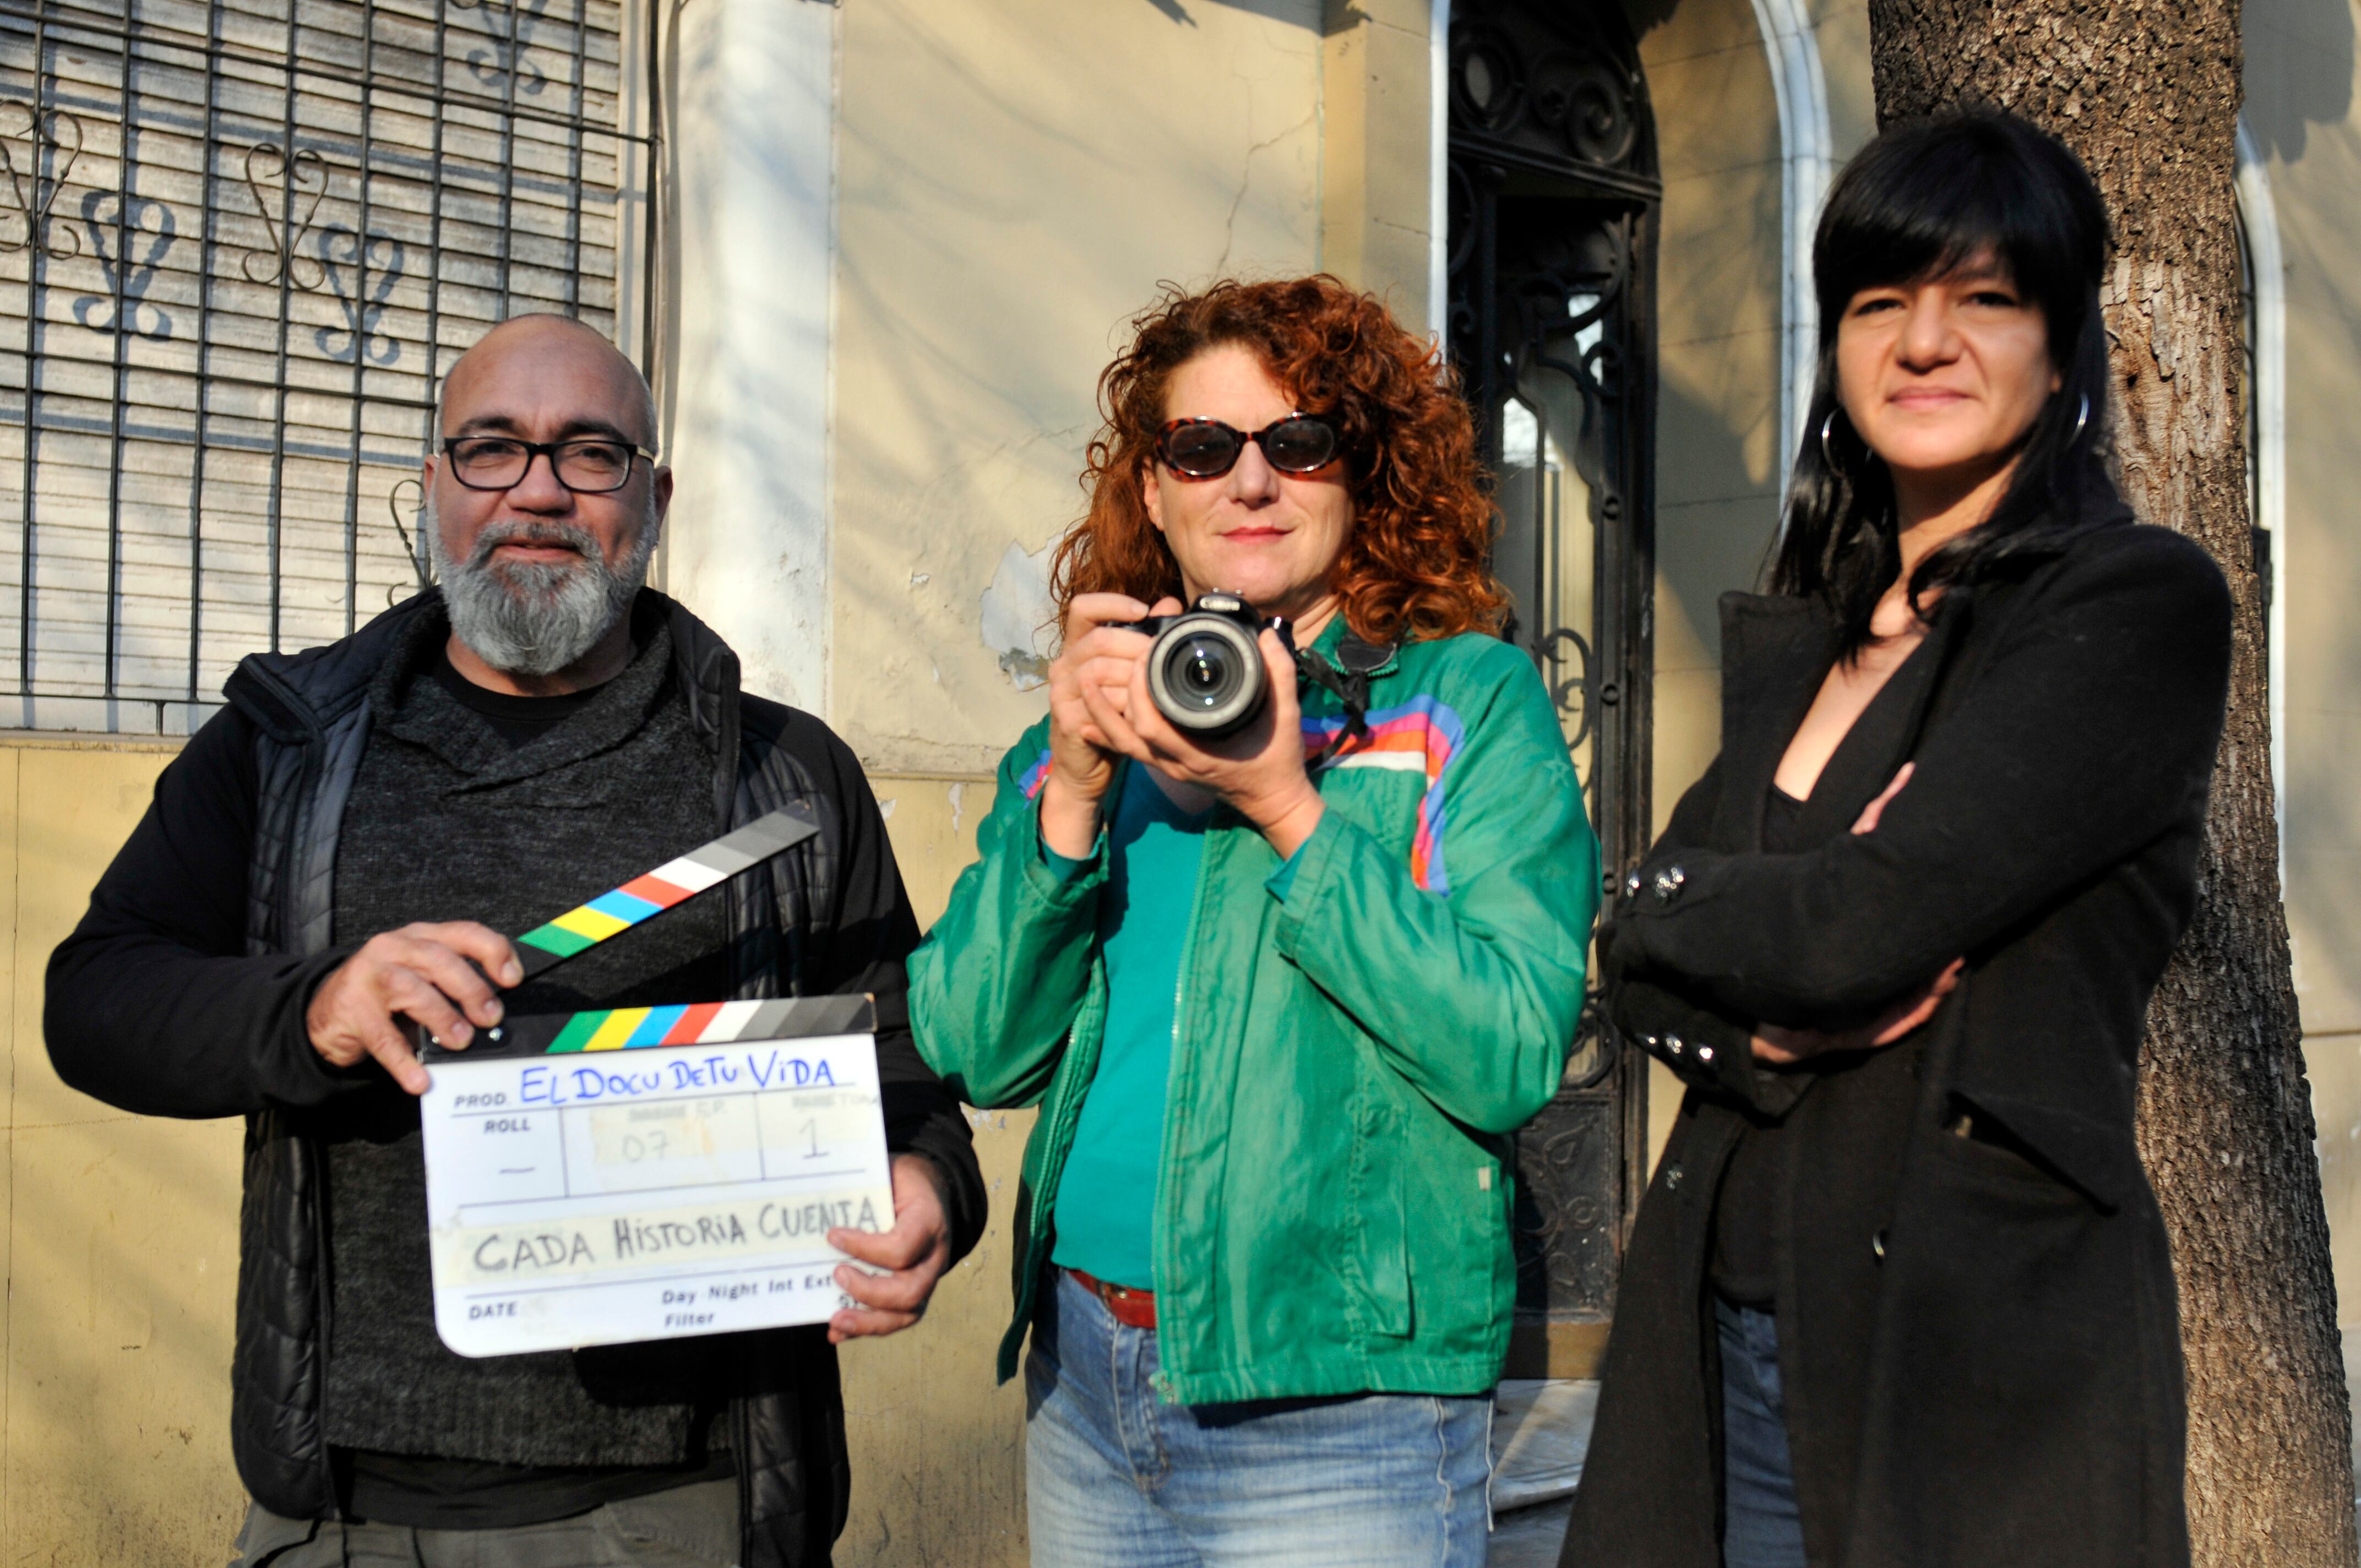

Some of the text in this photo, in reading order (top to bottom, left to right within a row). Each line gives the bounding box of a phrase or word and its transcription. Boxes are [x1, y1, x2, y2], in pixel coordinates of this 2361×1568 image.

[483, 1117, 531, 1135] ROLL
[799, 1117, 831, 1160] 1
[622, 1131, 670, 1163] 07
[474, 1232, 595, 1271] CADA
[759, 1196, 880, 1239] CUENTA
[662, 1275, 832, 1305] Day Night Int Ext
[468, 1302, 518, 1320] DATE
[665, 1313, 715, 1329] Filter
